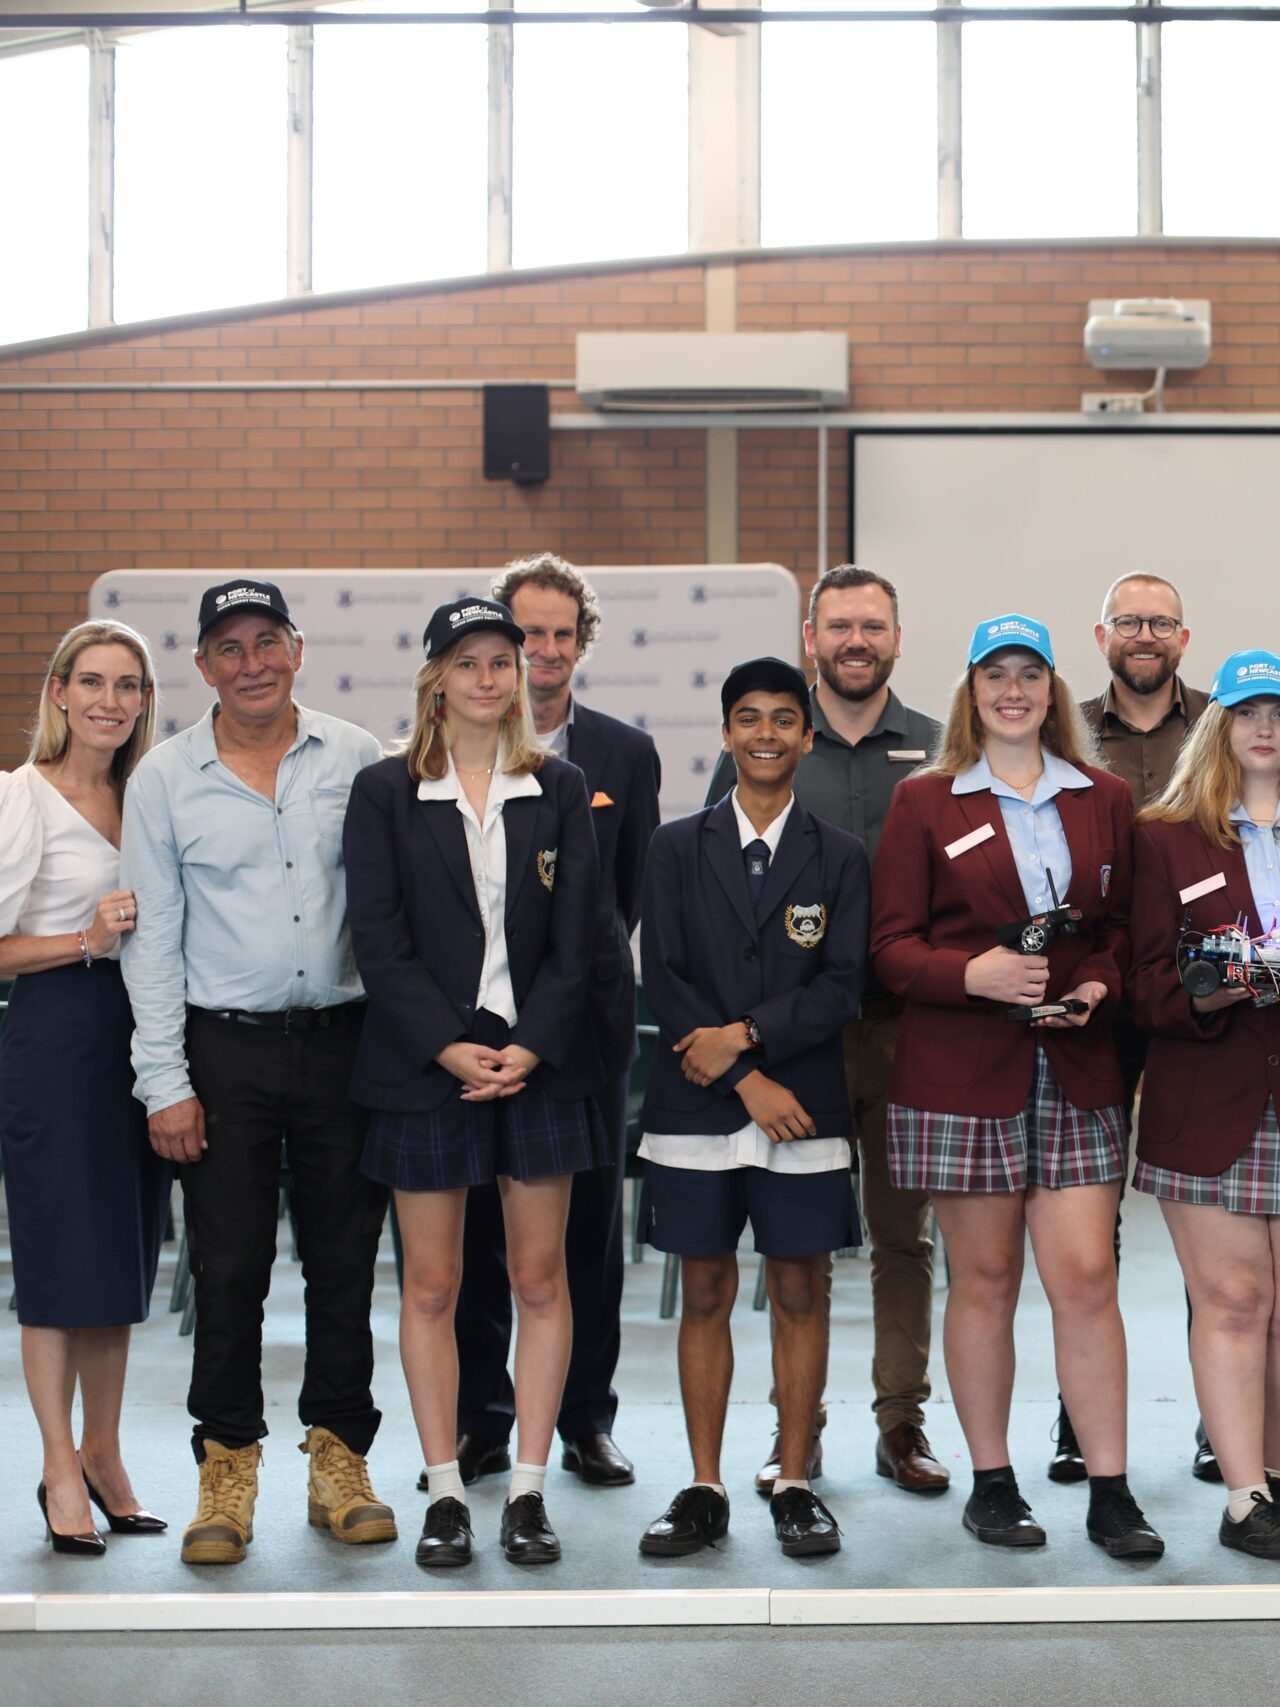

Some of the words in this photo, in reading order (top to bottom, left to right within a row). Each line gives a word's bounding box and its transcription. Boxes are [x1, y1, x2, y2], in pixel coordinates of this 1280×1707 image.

[227, 588, 247, 596] PORT
[228, 591, 270, 600] NEWCASTLE
[461, 605, 480, 613] PORT
[463, 610, 503, 618] NEWCASTLE
[1000, 625, 1039, 637] NEWCASTLE
